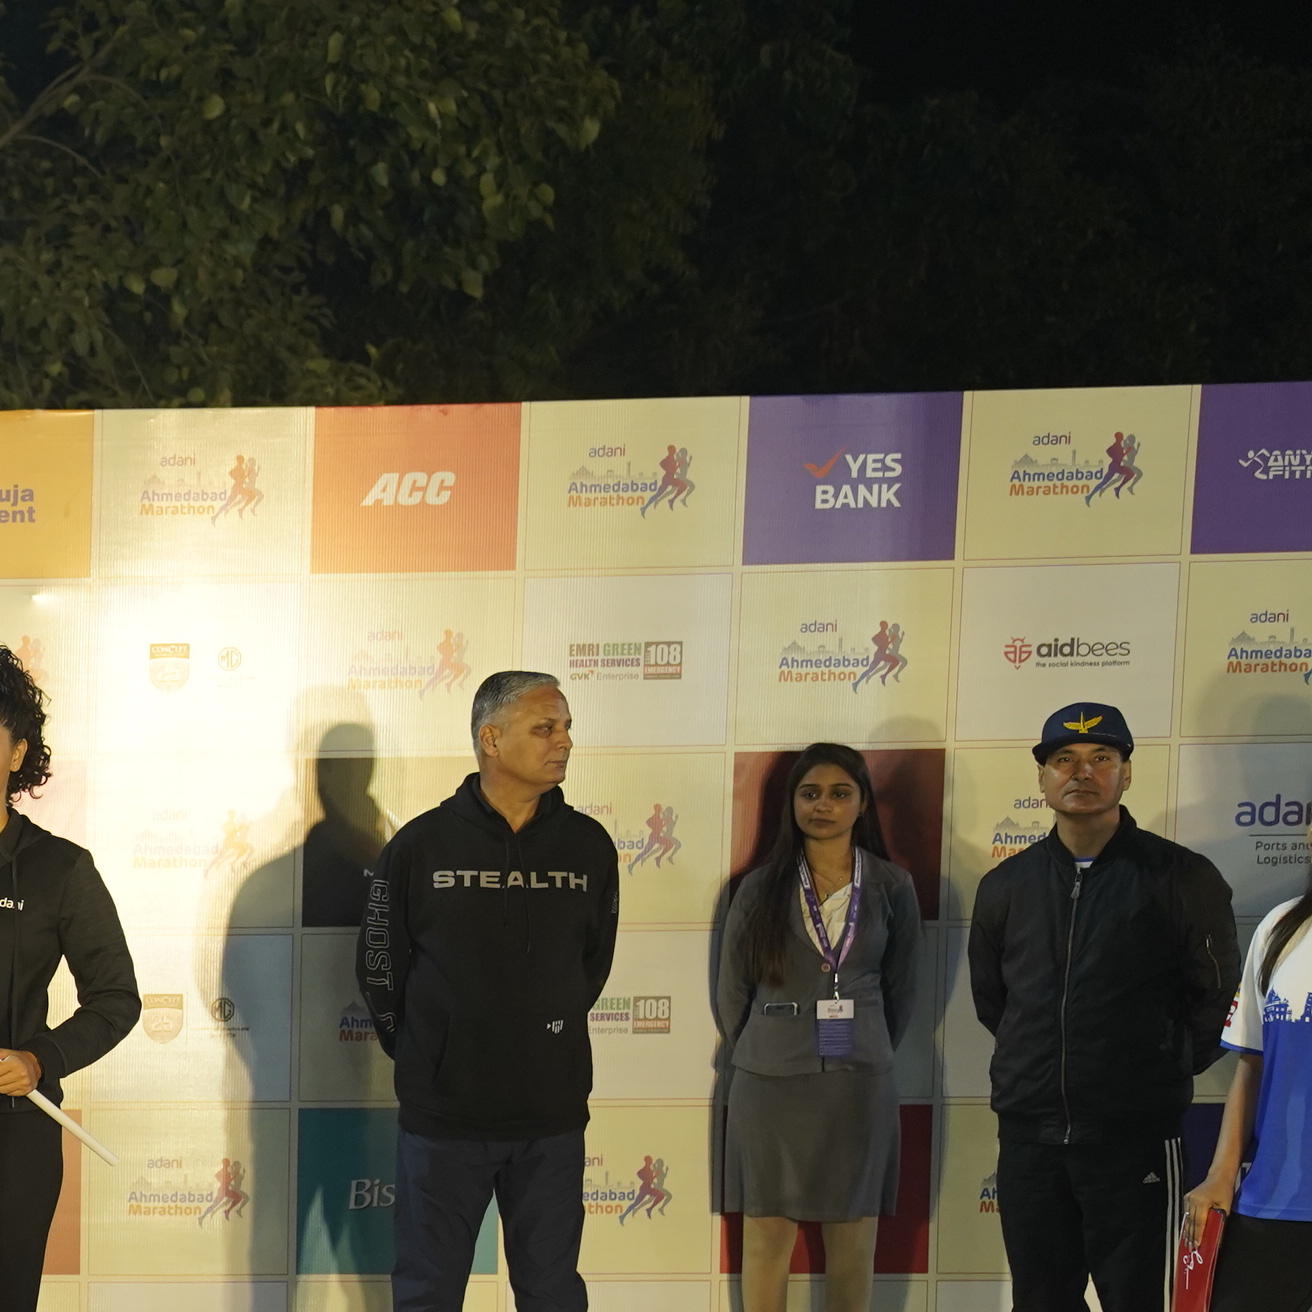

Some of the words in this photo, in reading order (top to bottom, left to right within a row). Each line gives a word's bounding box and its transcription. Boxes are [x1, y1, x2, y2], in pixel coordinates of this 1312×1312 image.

[1032, 431, 1072, 447] adani
[588, 443, 626, 458] adani
[845, 453, 903, 480] YES
[1009, 466, 1104, 486] Ahmedabad
[360, 470, 456, 507] ACC
[566, 479, 657, 495] Ahmedabad
[1008, 481, 1092, 499] Marathon
[566, 493, 646, 509] Marathon
[814, 483, 902, 510] BANK
[1250, 610, 1289, 623] adani
[799, 619, 838, 635] adani
[569, 643, 600, 657] EMRI
[603, 642, 642, 656] GREEN
[647, 644, 681, 666] 108
[1036, 637, 1130, 658] aidbees
[569, 659, 598, 668] HEALTH
[601, 658, 640, 668] SERVICES
[778, 654, 870, 671] Ahmedabad
[1101, 660, 1130, 668] platform
[1227, 660, 1309, 674] Marathon
[597, 672, 639, 681] Enterprise
[777, 668, 858, 684] Marathon
[1255, 841, 1287, 851] Ports
[1256, 855, 1310, 867] Logistics
[432, 869, 588, 893] STEALTH
[214, 1000, 232, 1019] MG
[590, 1012, 630, 1022] SERVICES
[636, 999, 669, 1019] 108
[146, 1156, 183, 1170] adani
[127, 1190, 214, 1205] Ahmedabad
[127, 1203, 203, 1217] Marathon
